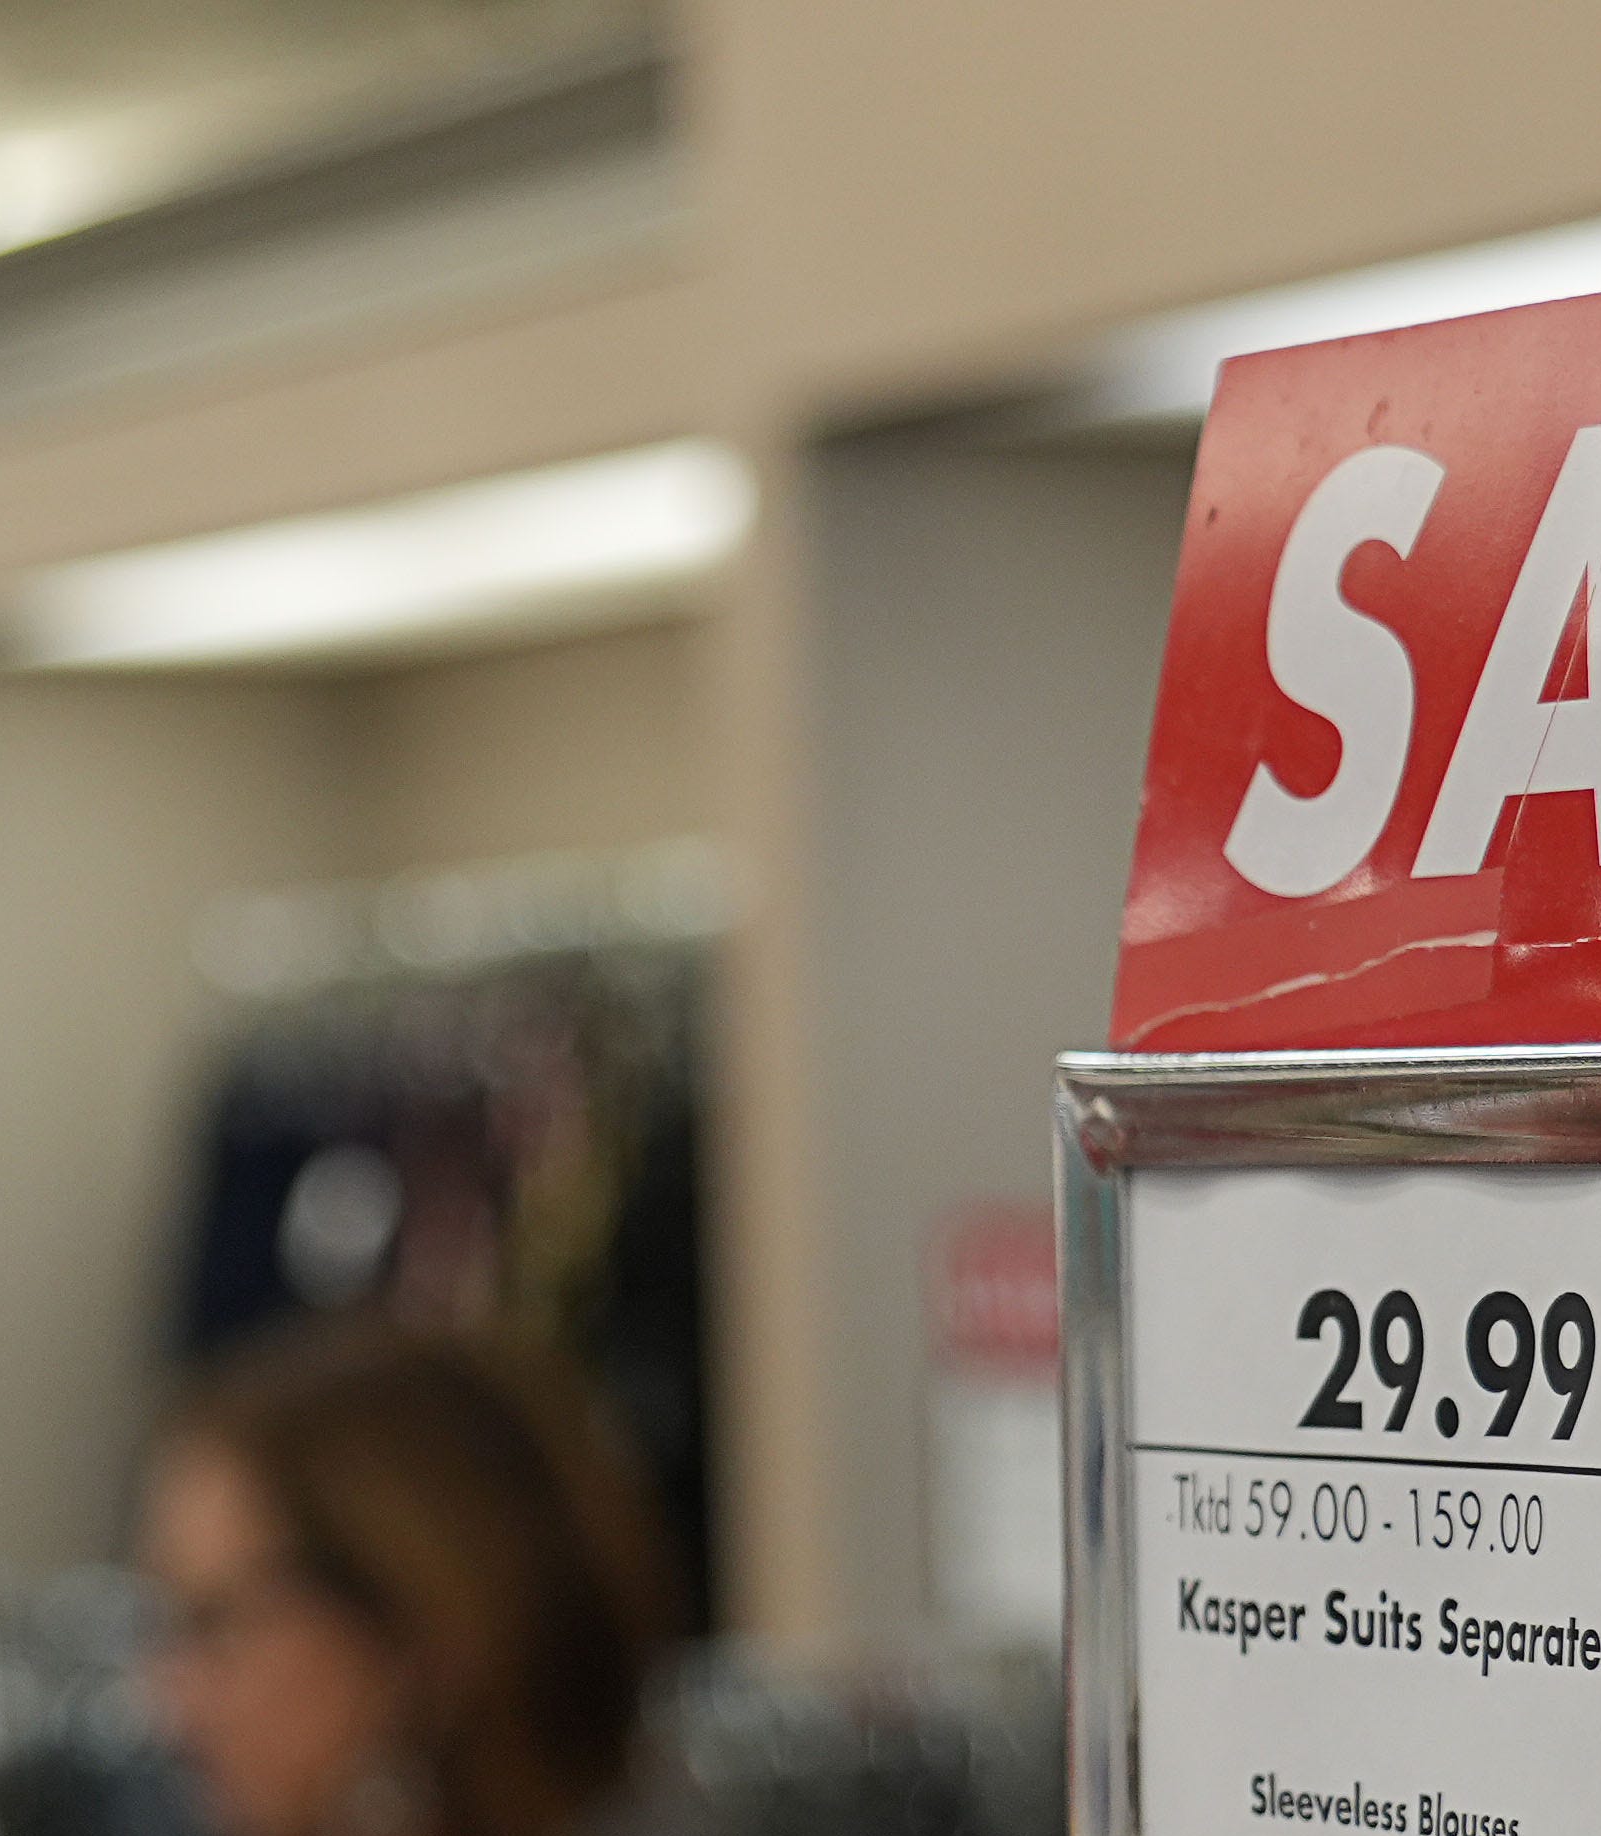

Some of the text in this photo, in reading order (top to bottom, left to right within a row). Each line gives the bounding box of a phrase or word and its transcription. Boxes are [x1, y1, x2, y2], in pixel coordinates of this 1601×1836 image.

[1297, 1289, 1596, 1440] 29.99
[1173, 1472, 1542, 1555] Tktd 59.00 - 159.00
[1178, 1577, 1306, 1654] Kasper
[1325, 1589, 1422, 1651] Suits
[1252, 1774, 1407, 1833] Sleeveless
